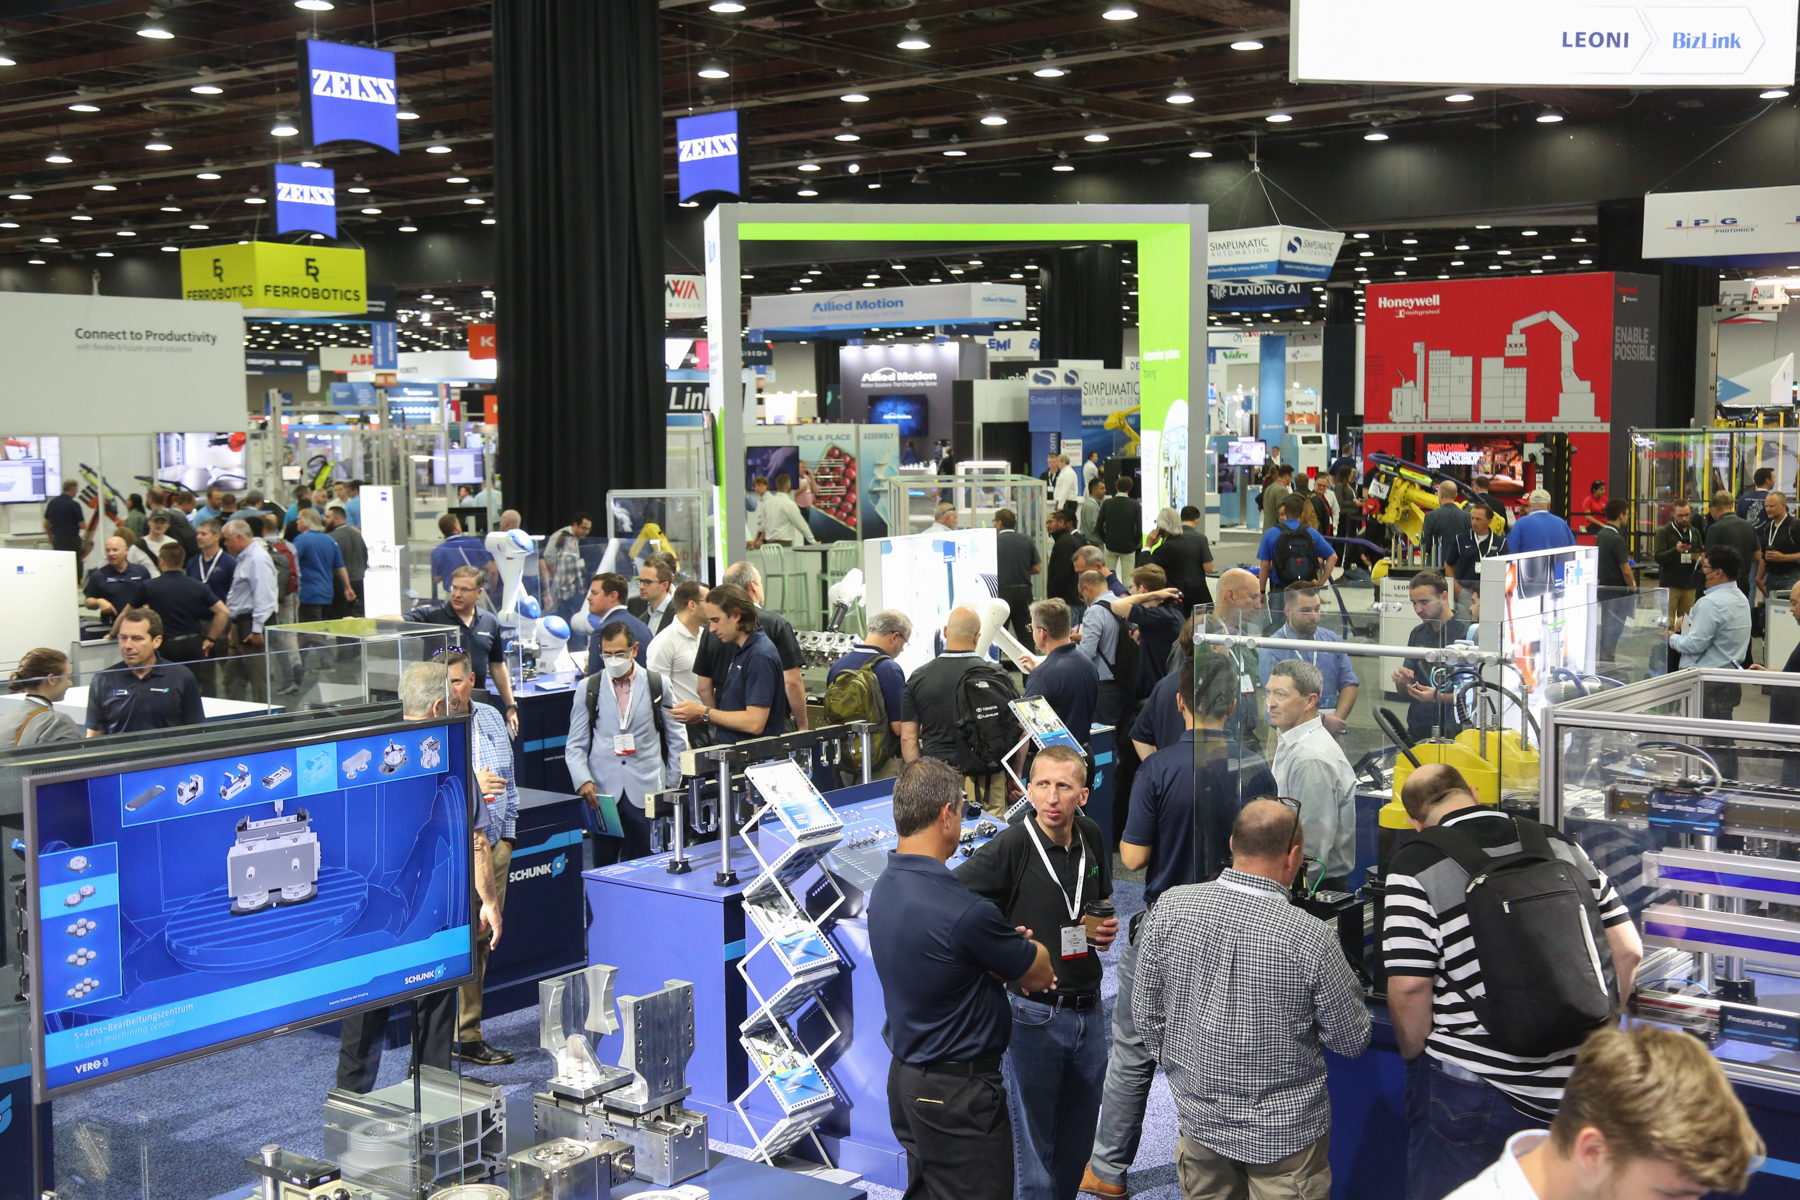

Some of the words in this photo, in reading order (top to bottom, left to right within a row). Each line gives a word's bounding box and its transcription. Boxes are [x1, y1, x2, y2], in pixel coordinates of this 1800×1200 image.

[1562, 31, 1630, 48] LEONI
[1672, 32, 1742, 49] BizLink
[312, 69, 396, 105] ZEISS
[678, 133, 738, 162] ZEISS
[277, 182, 336, 206] ZEISS
[1209, 238, 1269, 251] SIMPLIMATIC
[1211, 247, 1270, 257] AUTOMATION
[187, 285, 253, 301] FERROBOTICS
[264, 285, 360, 302] FERROBOTICS
[1229, 284, 1285, 296] LANDING
[1288, 284, 1301, 294] AI
[812, 299, 853, 313] Allied
[855, 298, 904, 311] Motion
[1378, 294, 1440, 310] Honeywell
[75, 328, 127, 341] Connect
[130, 329, 143, 340] to
[145, 330, 217, 346] Productivity
[1614, 326, 1649, 344] ENABLE
[988, 338, 1011, 351] EMI
[1614, 344, 1656, 361] POSSIBLE
[861, 371, 896, 382] Allied
[896, 371, 937, 381] Motion
[1083, 381, 1140, 396] SIMPLIMATIC
[1030, 395, 1057, 406] Smart
[1083, 398, 1140, 407] AUTOMATION
[825, 433, 851, 441] PLACE
[863, 432, 894, 440] ASSEMBLY
[1644, 450, 1695, 460] Honeywell
[509, 862, 552, 883] SCHUNK
[404, 970, 434, 985] SCHUNK
[74, 1003, 194, 1040] 5-Achs-Bearbeitungszentrum
[1727, 1014, 1766, 1027] Pneumatic
[1767, 1021, 1787, 1030] Drive
[104, 1024, 148, 1044] machining
[150, 1018, 176, 1032] center
